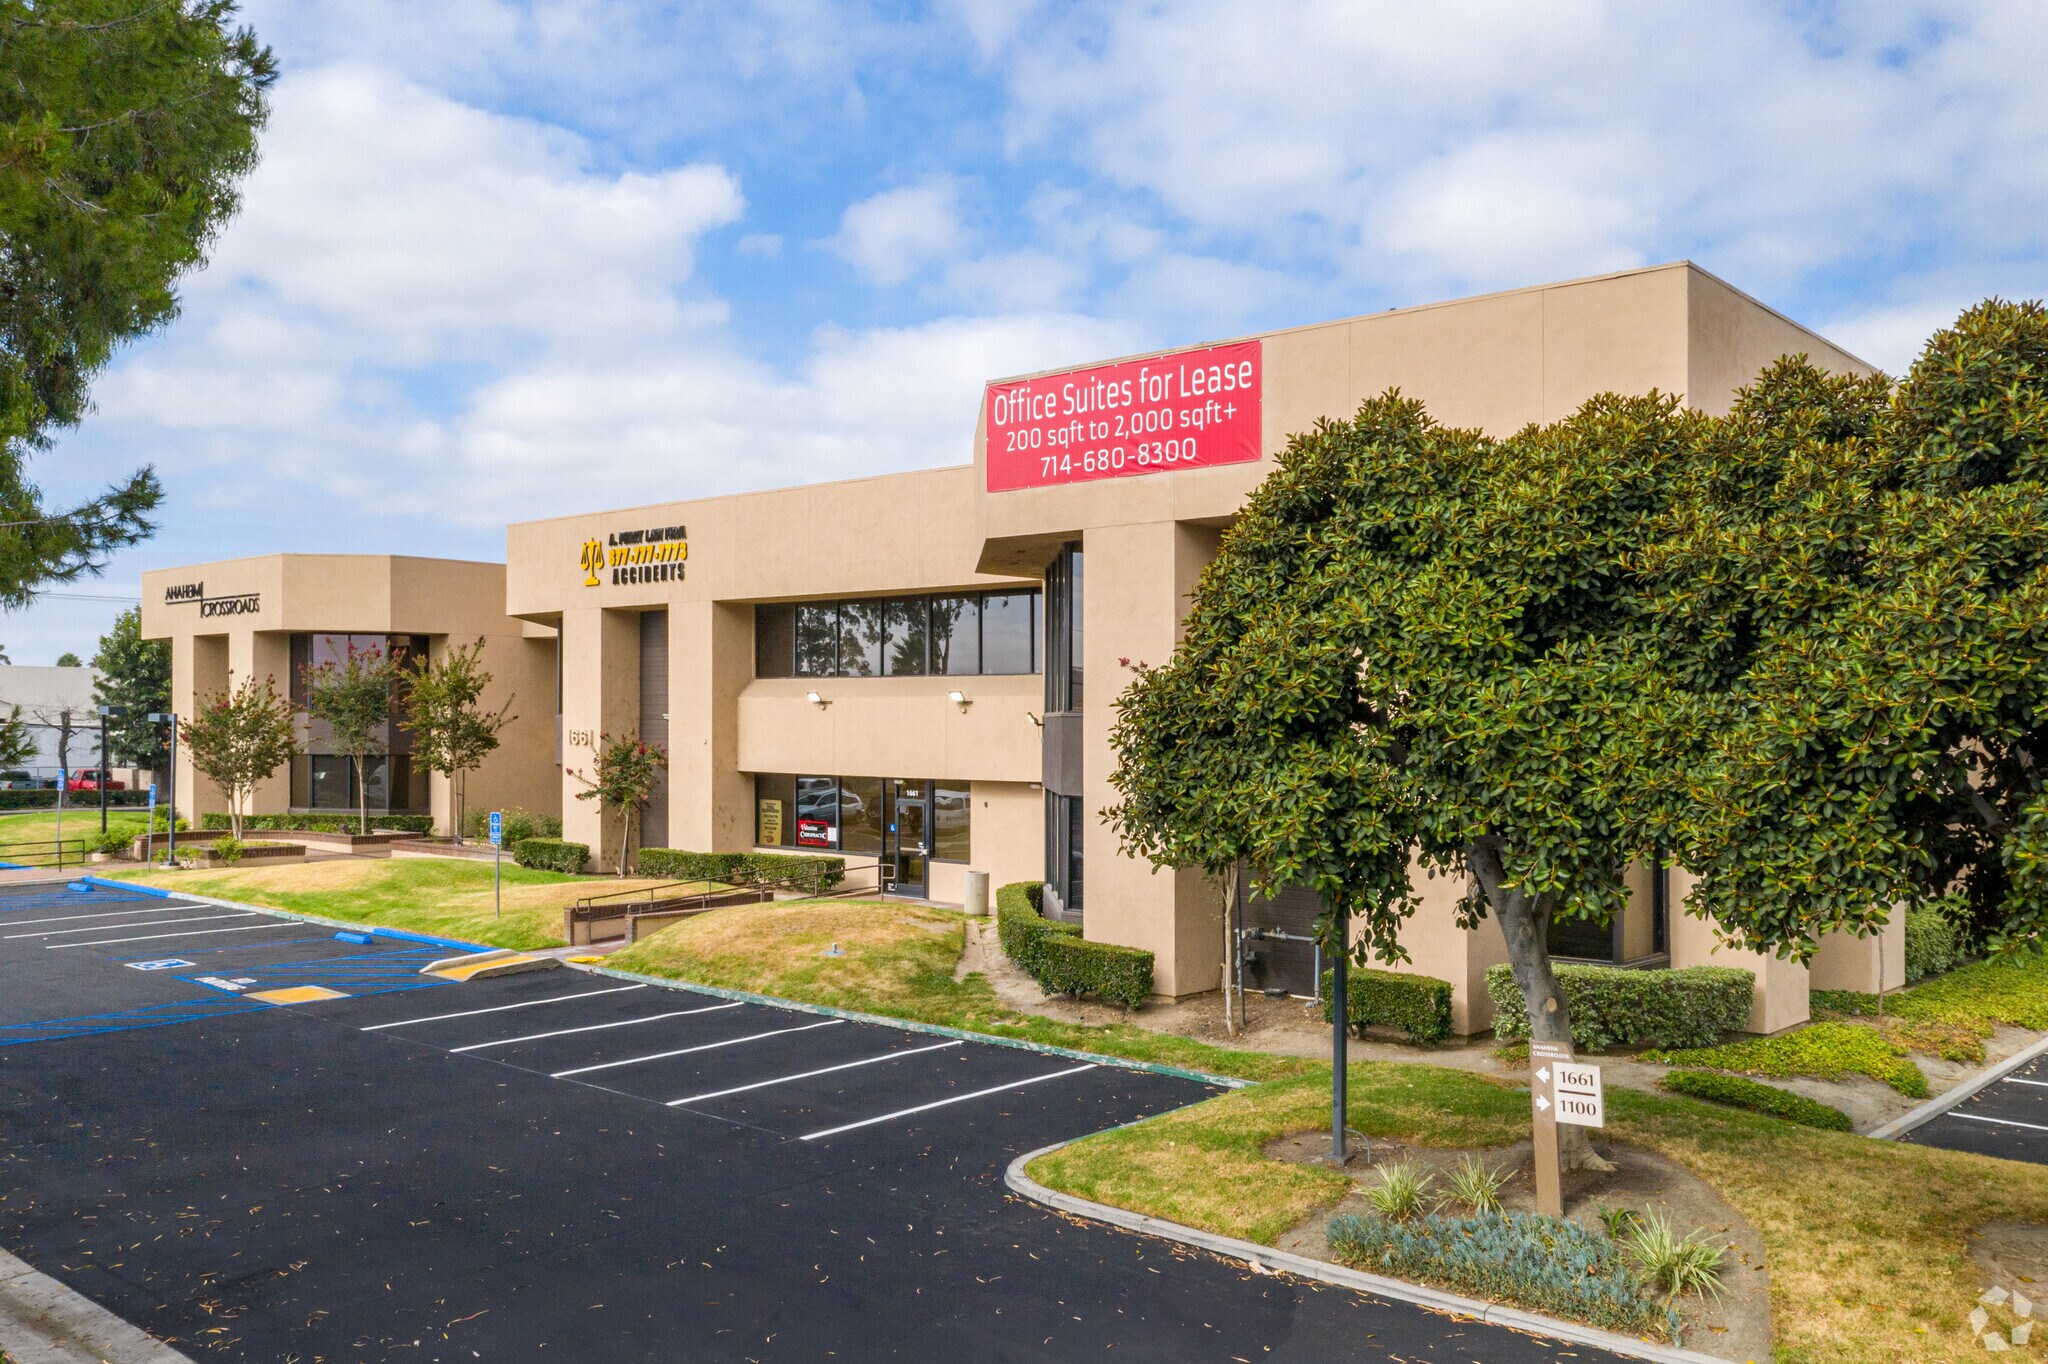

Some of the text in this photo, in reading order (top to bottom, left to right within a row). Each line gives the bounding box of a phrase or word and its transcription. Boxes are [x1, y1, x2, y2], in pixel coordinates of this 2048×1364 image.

[994, 359, 1252, 425] Office Suites for Lease
[1006, 400, 1237, 452] 200 sqft to 2,000 sqft+
[1041, 437, 1197, 478] 714-680-8300
[645, 528, 664, 543] LAW
[612, 562, 685, 586] ACCIDENTS
[165, 583, 201, 601] ANAHEIM
[203, 597, 260, 618] CROSSROADS
[1533, 1044, 1559, 1052] ANAHEIM
[1533, 1050, 1570, 1060] CROSSROADS
[1560, 1071, 1594, 1087] 1661
[1560, 1100, 1597, 1116] 1100
